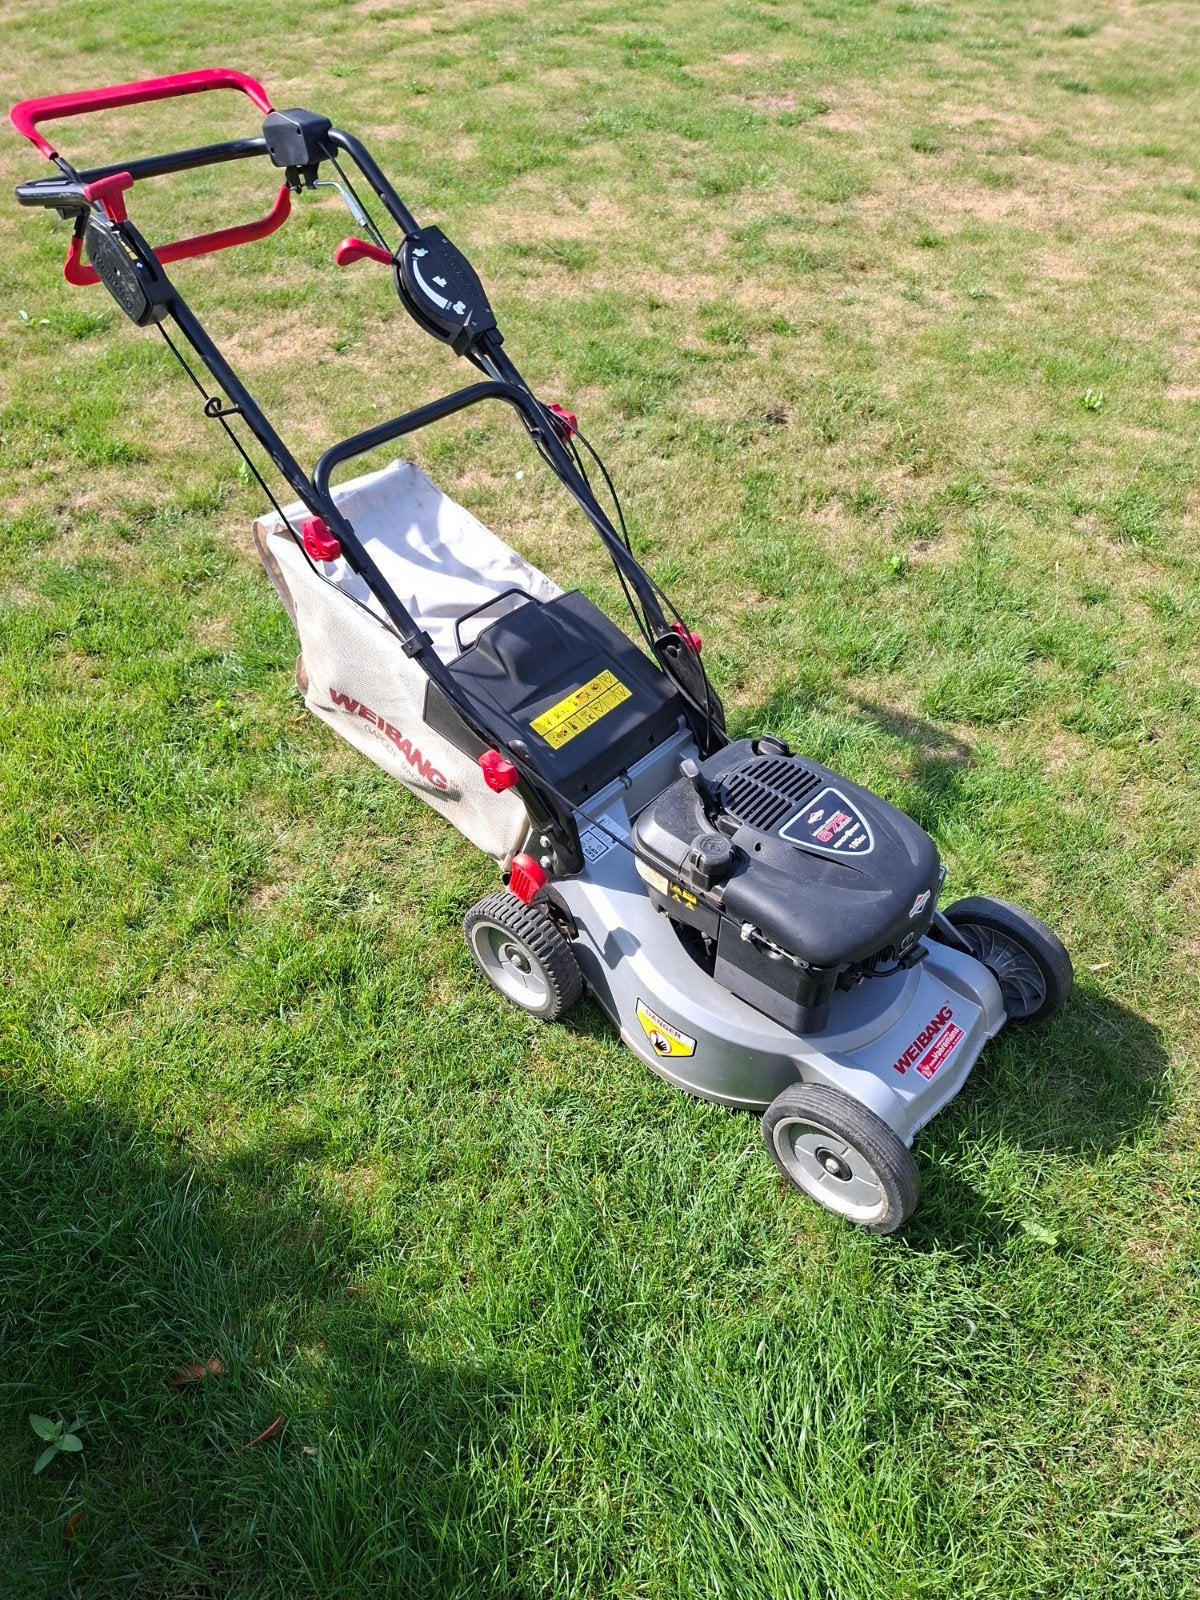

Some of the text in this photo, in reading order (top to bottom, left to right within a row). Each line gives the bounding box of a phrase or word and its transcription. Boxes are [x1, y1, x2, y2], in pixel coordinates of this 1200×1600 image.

[329, 687, 447, 790] WEIBANG
[585, 845, 599, 858] 96
[892, 1005, 953, 1075] WEIBANG
[931, 1026, 960, 1060] Vaeremans
